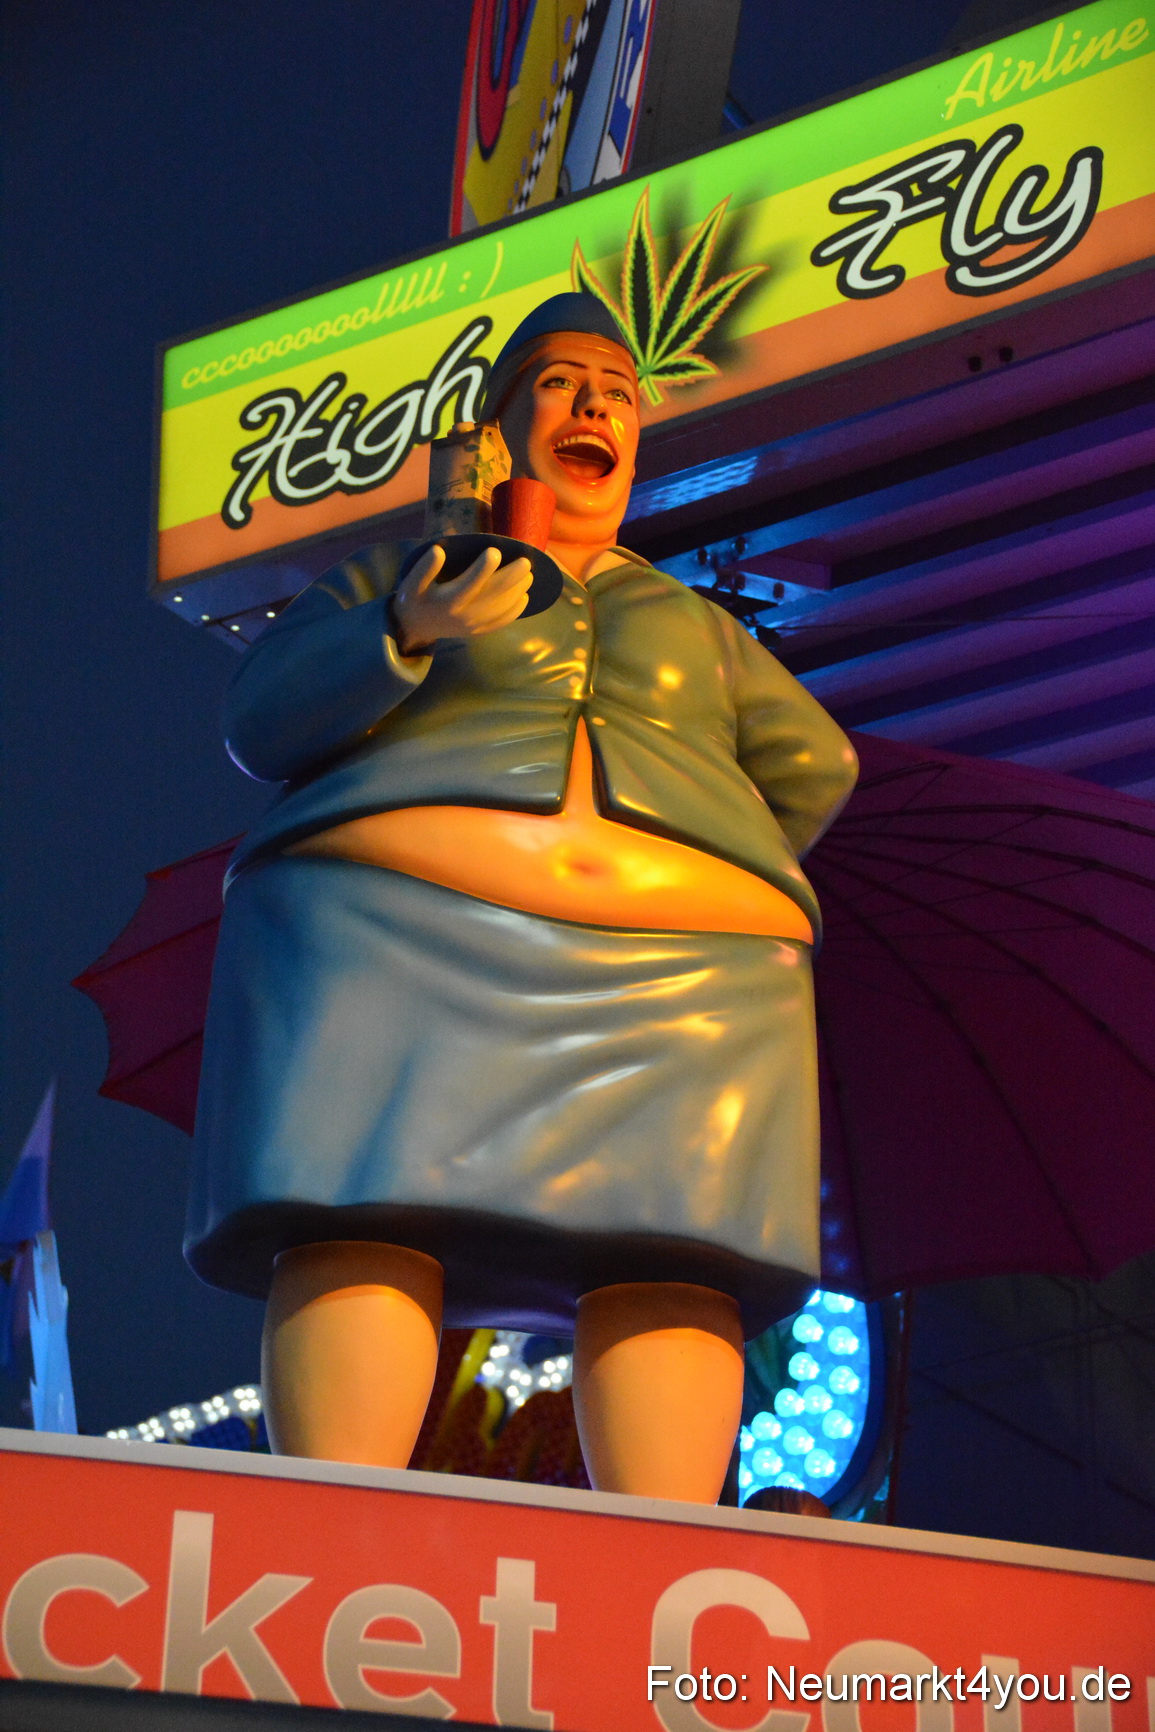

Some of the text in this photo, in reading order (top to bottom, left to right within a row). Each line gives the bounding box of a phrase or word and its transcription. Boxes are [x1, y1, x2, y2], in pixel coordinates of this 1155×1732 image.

[944, 17, 1149, 120] Airline
[221, 123, 1104, 530] High Fly
